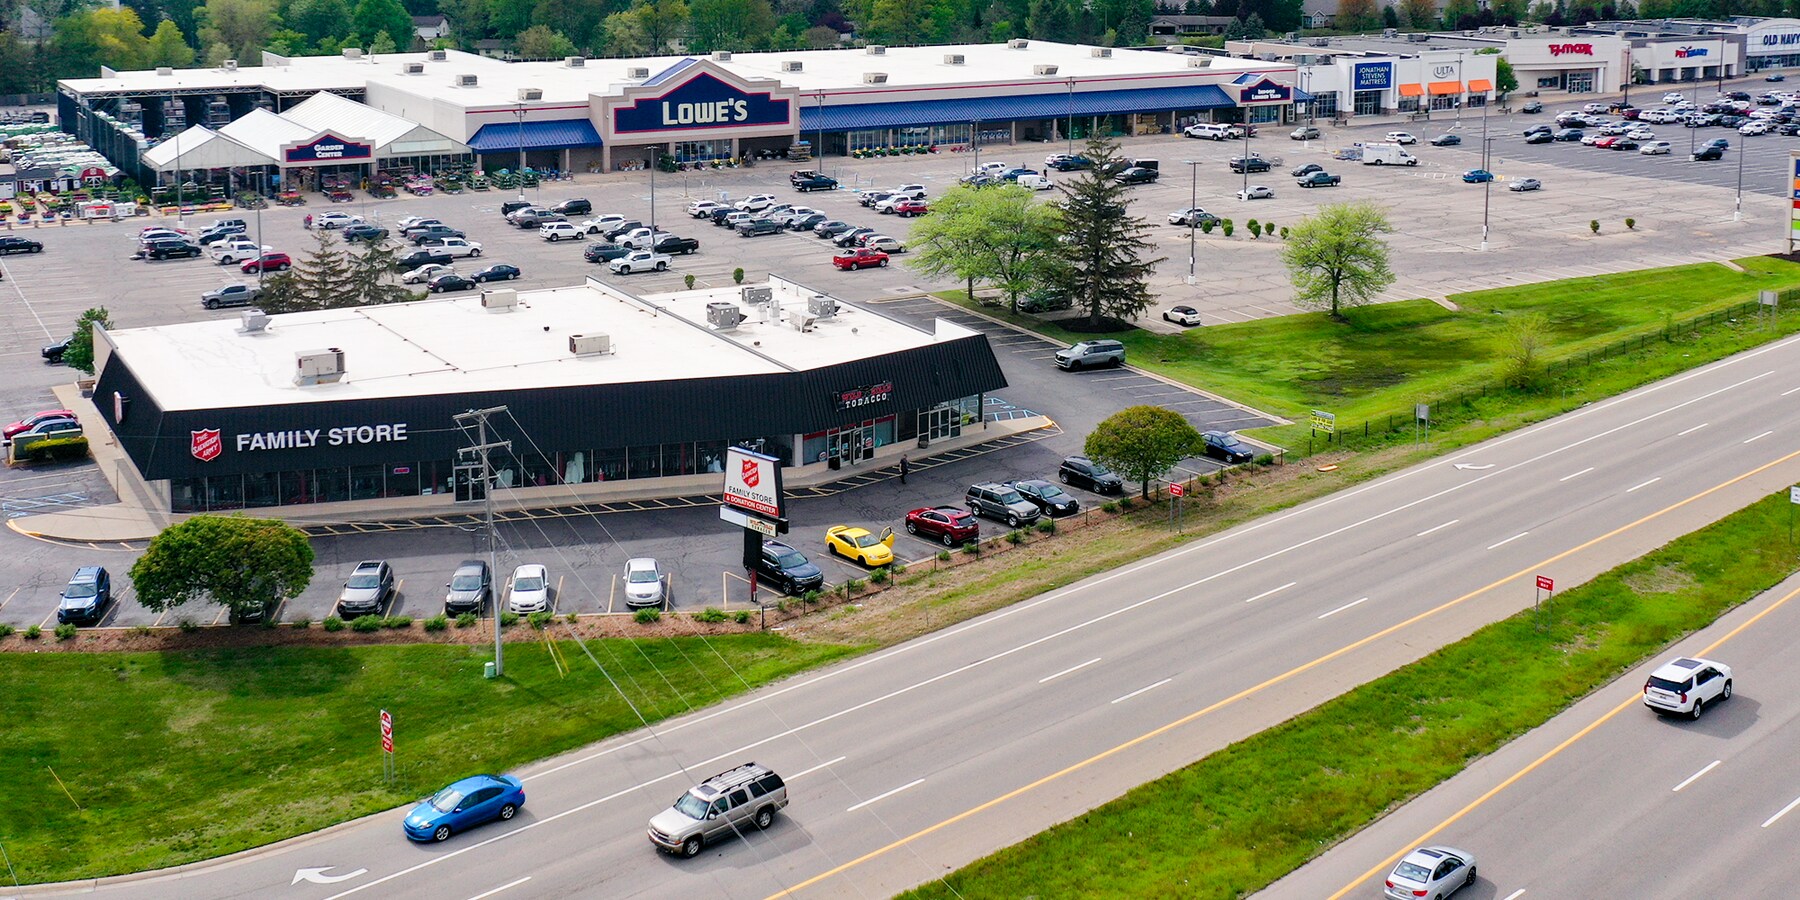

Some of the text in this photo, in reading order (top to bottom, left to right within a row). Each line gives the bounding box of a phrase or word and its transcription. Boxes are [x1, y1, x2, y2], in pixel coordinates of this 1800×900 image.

[1763, 34, 1778, 45] OLD
[1436, 65, 1455, 75] ULTA
[662, 98, 748, 125] LOWE'S
[845, 392, 887, 408] TOBACCO
[236, 423, 408, 452] FAMILY STORE
[728, 485, 773, 505] FAMILY STORE
[730, 496, 756, 509] DONATION
[756, 502, 776, 514] CENTER
